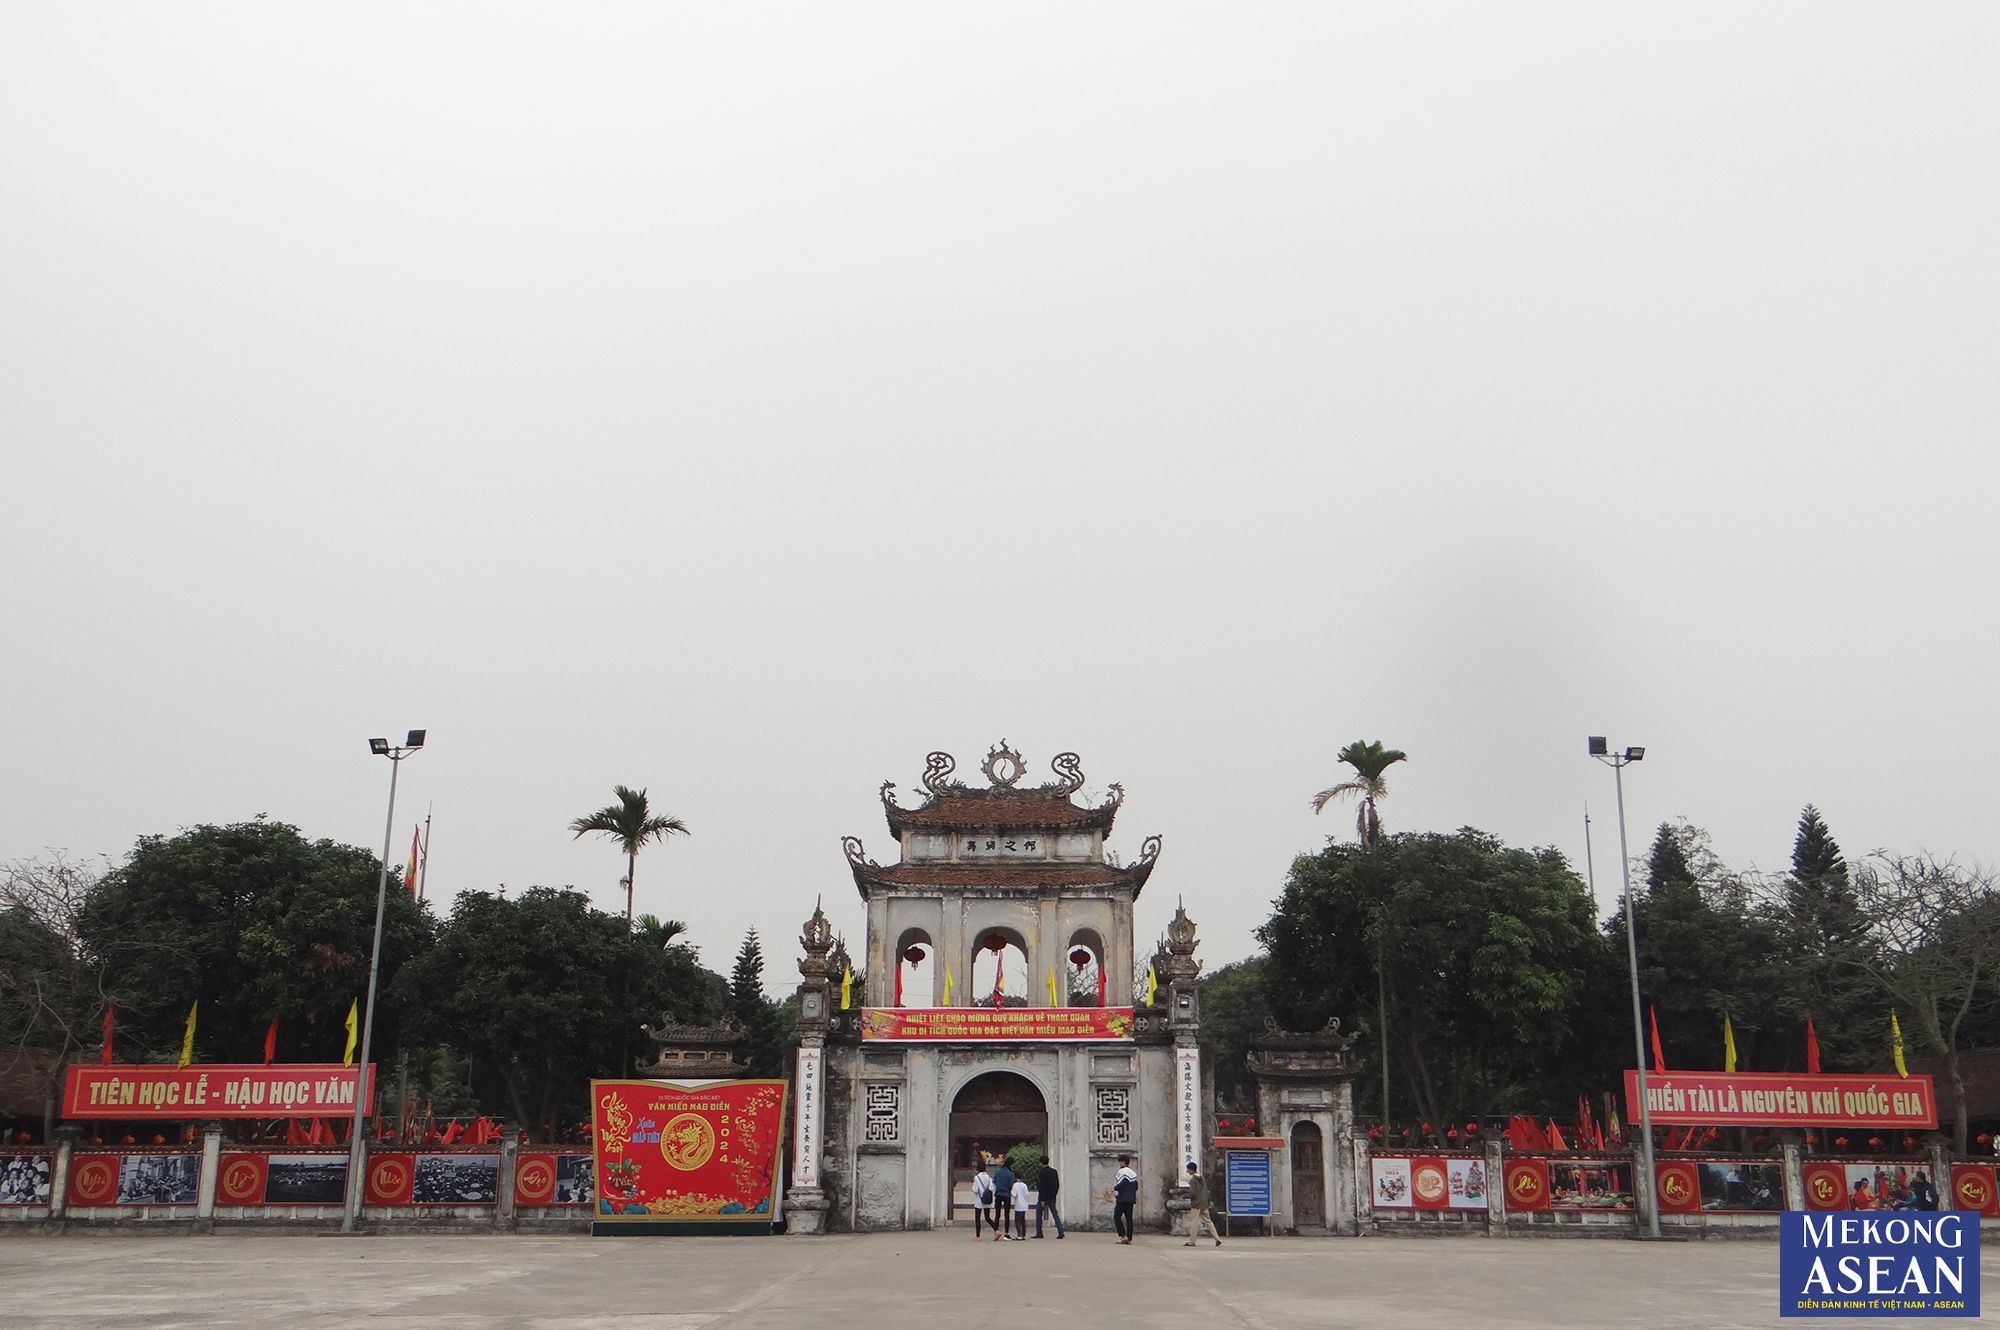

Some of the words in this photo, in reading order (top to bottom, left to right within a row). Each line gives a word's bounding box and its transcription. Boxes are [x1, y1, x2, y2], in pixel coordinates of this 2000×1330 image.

[906, 1014, 927, 1023] NHIỆT
[929, 1014, 944, 1023] LIỆT
[968, 1013, 990, 1022] MỪNG
[1009, 1013, 1033, 1021] KHÁCH
[902, 1027, 916, 1035] KHU
[919, 1027, 926, 1035] DI
[929, 1026, 945, 1035] TÍCH
[948, 1025, 967, 1034] QUỐC
[1002, 1026, 1017, 1035] BIỆT
[1020, 1026, 1034, 1034] VĂN
[1037, 1024, 1055, 1034] MIẾU
[1077, 1024, 1094, 1034] ĐIỀN
[89, 1077, 136, 1105] TIÊN
[138, 1081, 180, 1109] HỌC
[184, 1073, 209, 1105] LỄ
[224, 1077, 266, 1109] HẬU
[269, 1081, 312, 1109] HỌC
[315, 1076, 355, 1104] VĂN
[1647, 1082, 1685, 1112] HIỀN
[1688, 1084, 1714, 1112] TÀI
[1717, 1085, 1737, 1113] LÀ
[1741, 1088, 1809, 1115] NGUYÊN
[1811, 1084, 1841, 1115] KHÍ
[1843, 1084, 1889, 1117] QUỐC
[1893, 1092, 1923, 1116] GIA
[648, 1102, 666, 1110] VĂN
[668, 1101, 687, 1110] MIẾU
[710, 1101, 730, 1110] ĐIỀN
